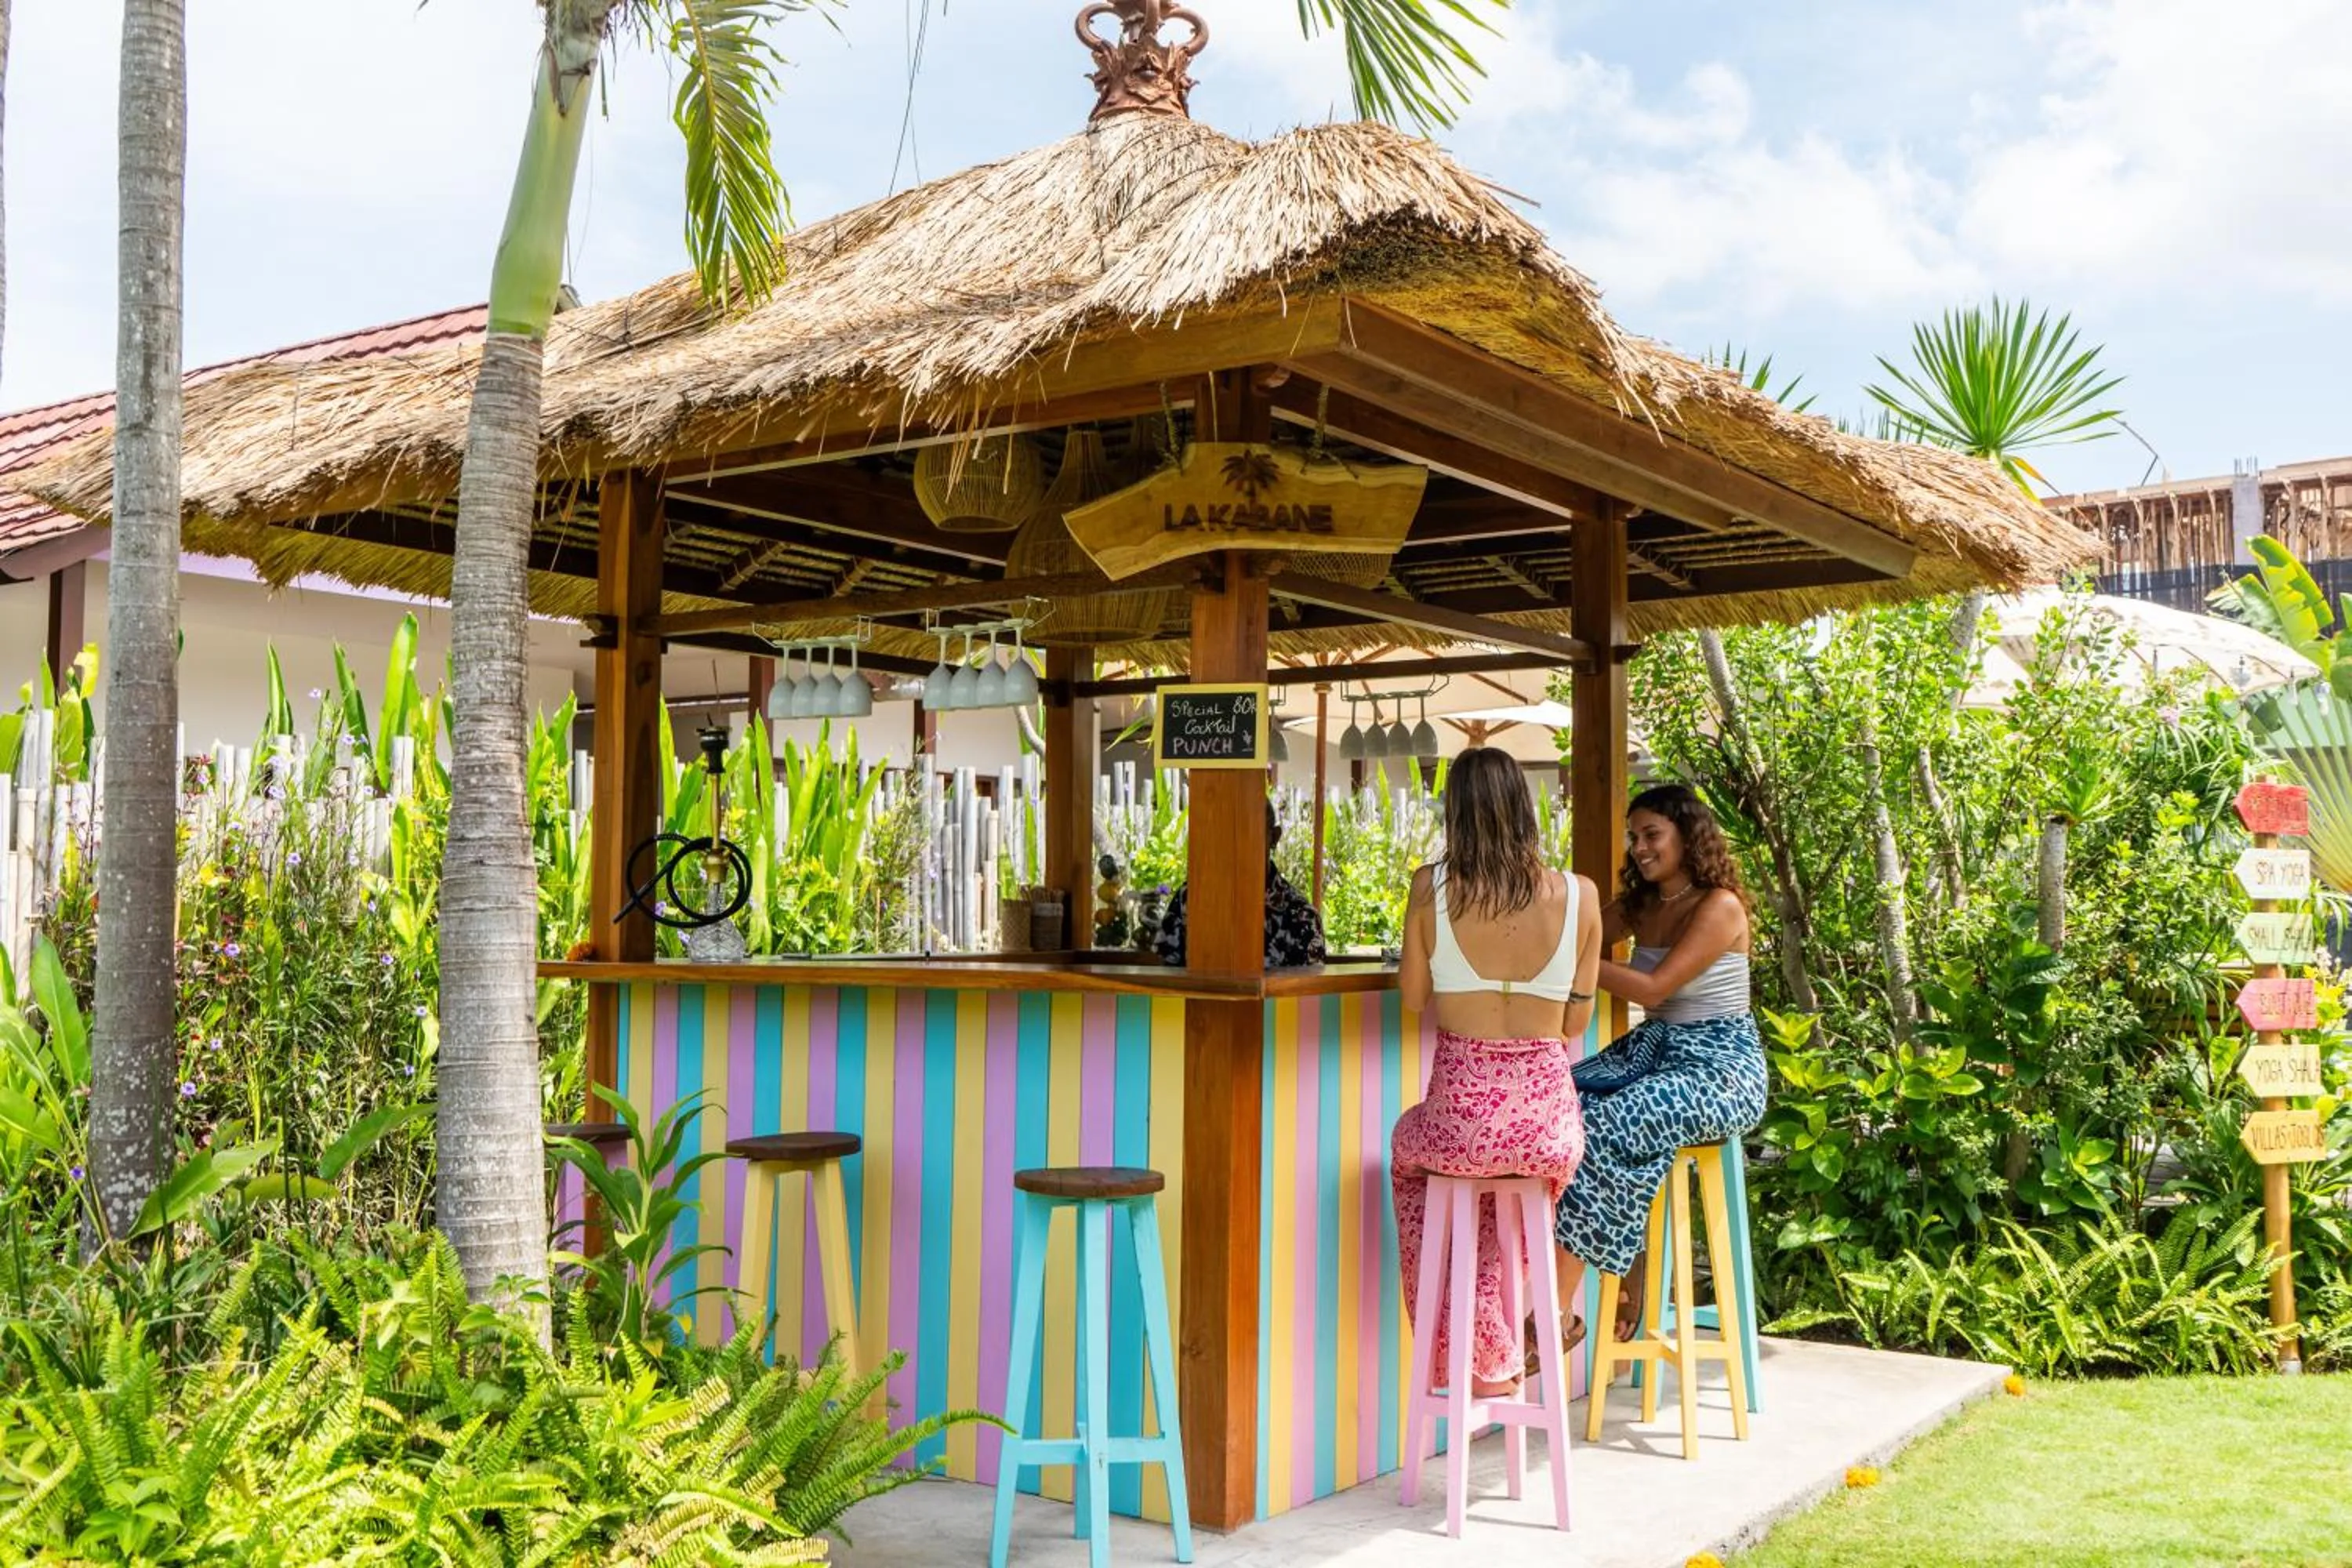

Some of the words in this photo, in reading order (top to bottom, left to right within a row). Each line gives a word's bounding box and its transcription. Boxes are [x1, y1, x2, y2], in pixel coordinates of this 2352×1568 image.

[1207, 503, 1334, 532] KABANE
[1172, 737, 1233, 755] PUNCH
[2257, 860, 2275, 885] SPA
[2256, 1059, 2283, 1083] YOGA
[2288, 1058, 2320, 1083] SHALA
[2251, 1125, 2286, 1150] VILLAS
